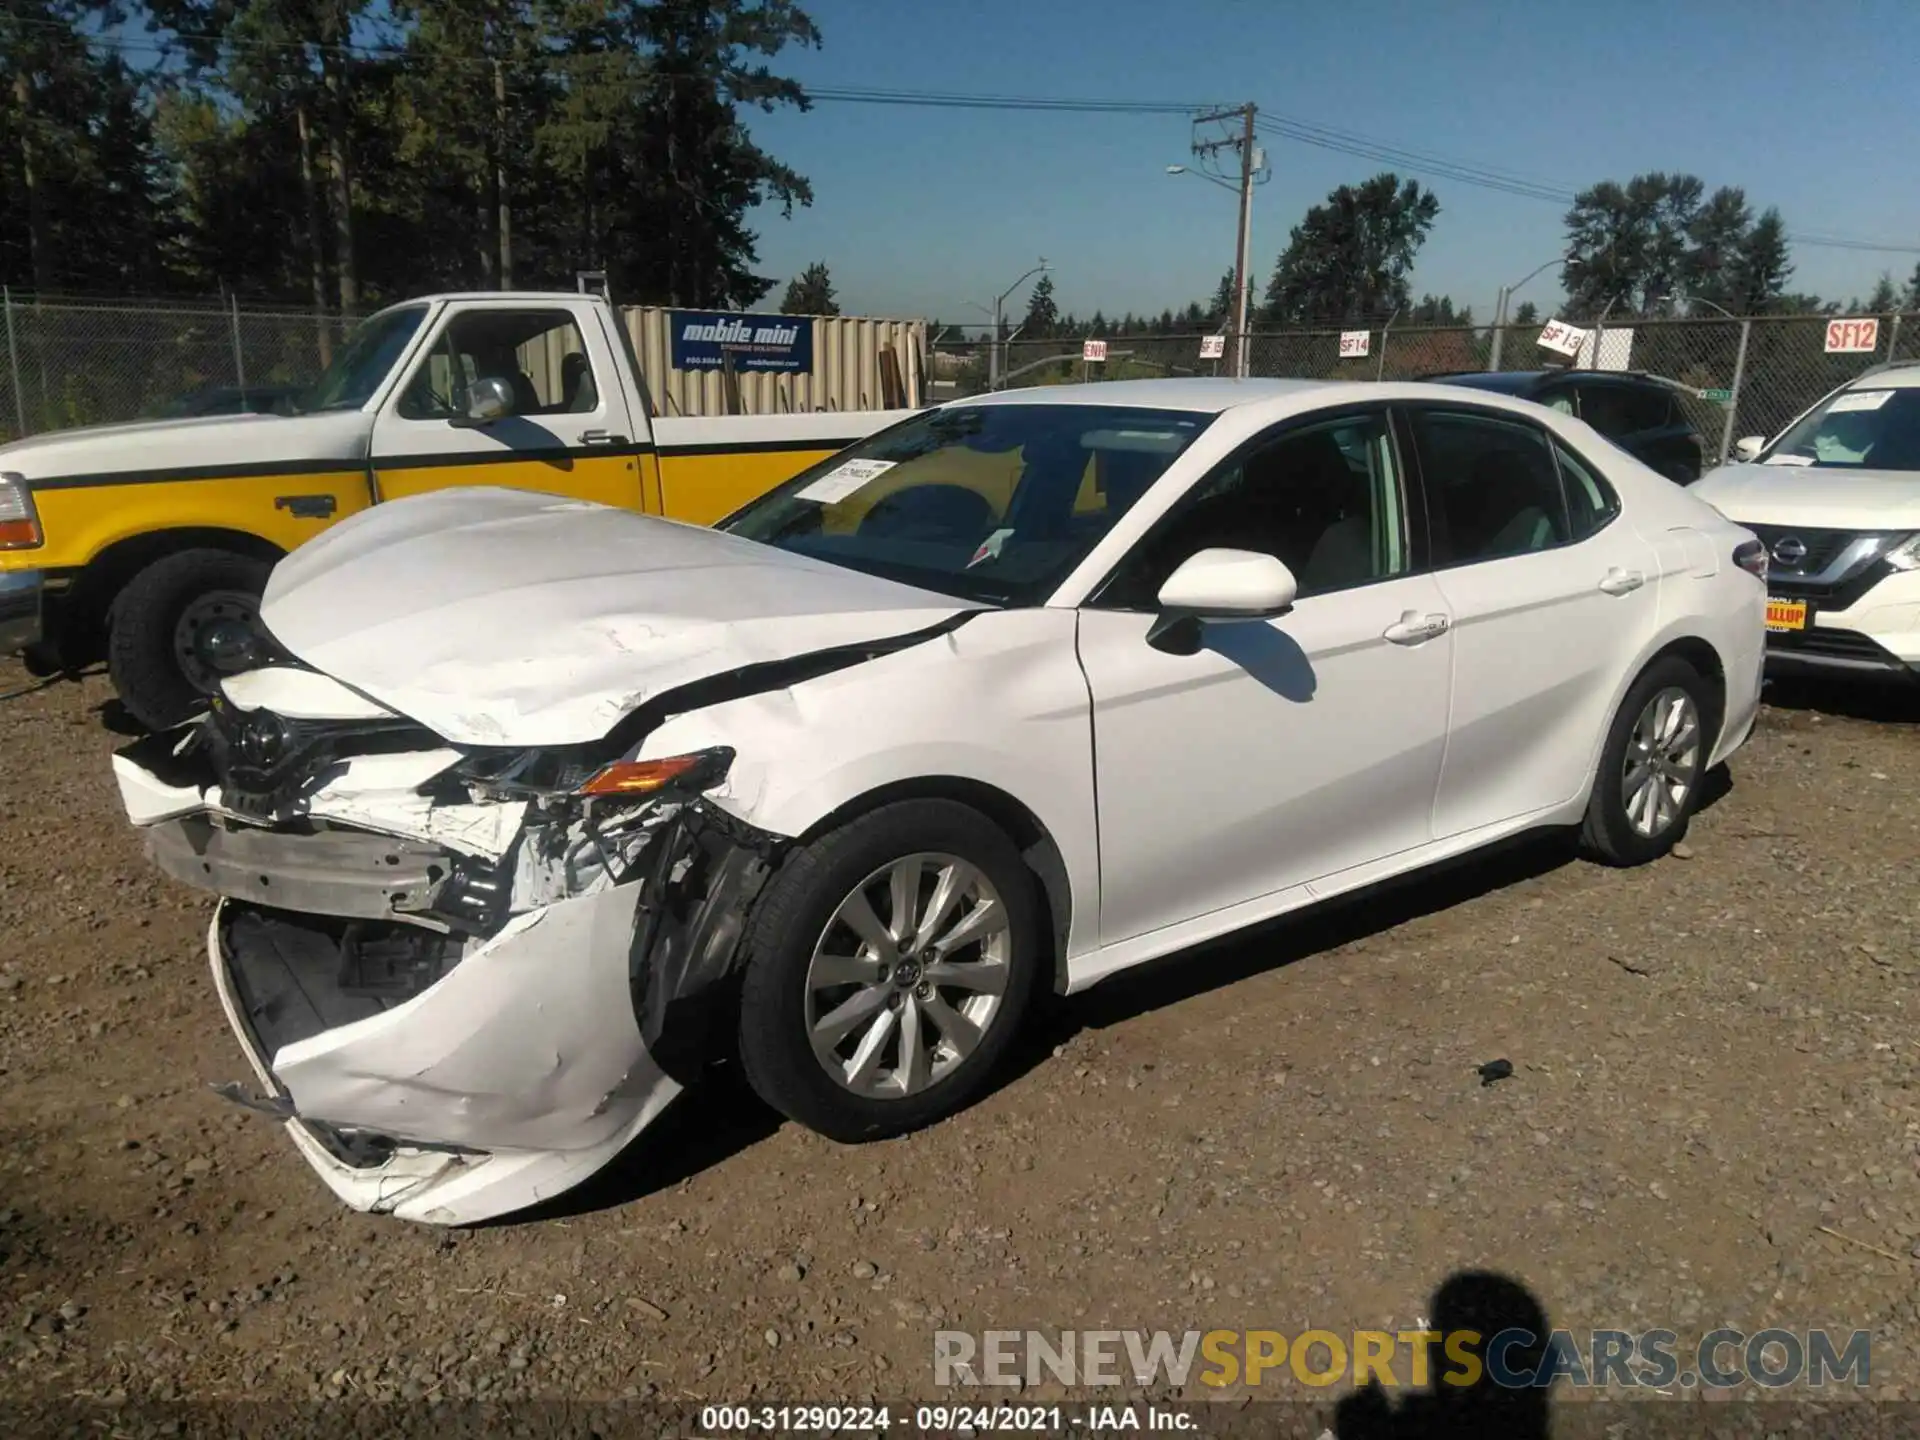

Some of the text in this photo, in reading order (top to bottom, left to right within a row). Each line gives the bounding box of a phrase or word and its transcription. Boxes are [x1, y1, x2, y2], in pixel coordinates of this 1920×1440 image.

[682, 318, 799, 345] mobile mini
[1828, 322, 1875, 349] SF12
